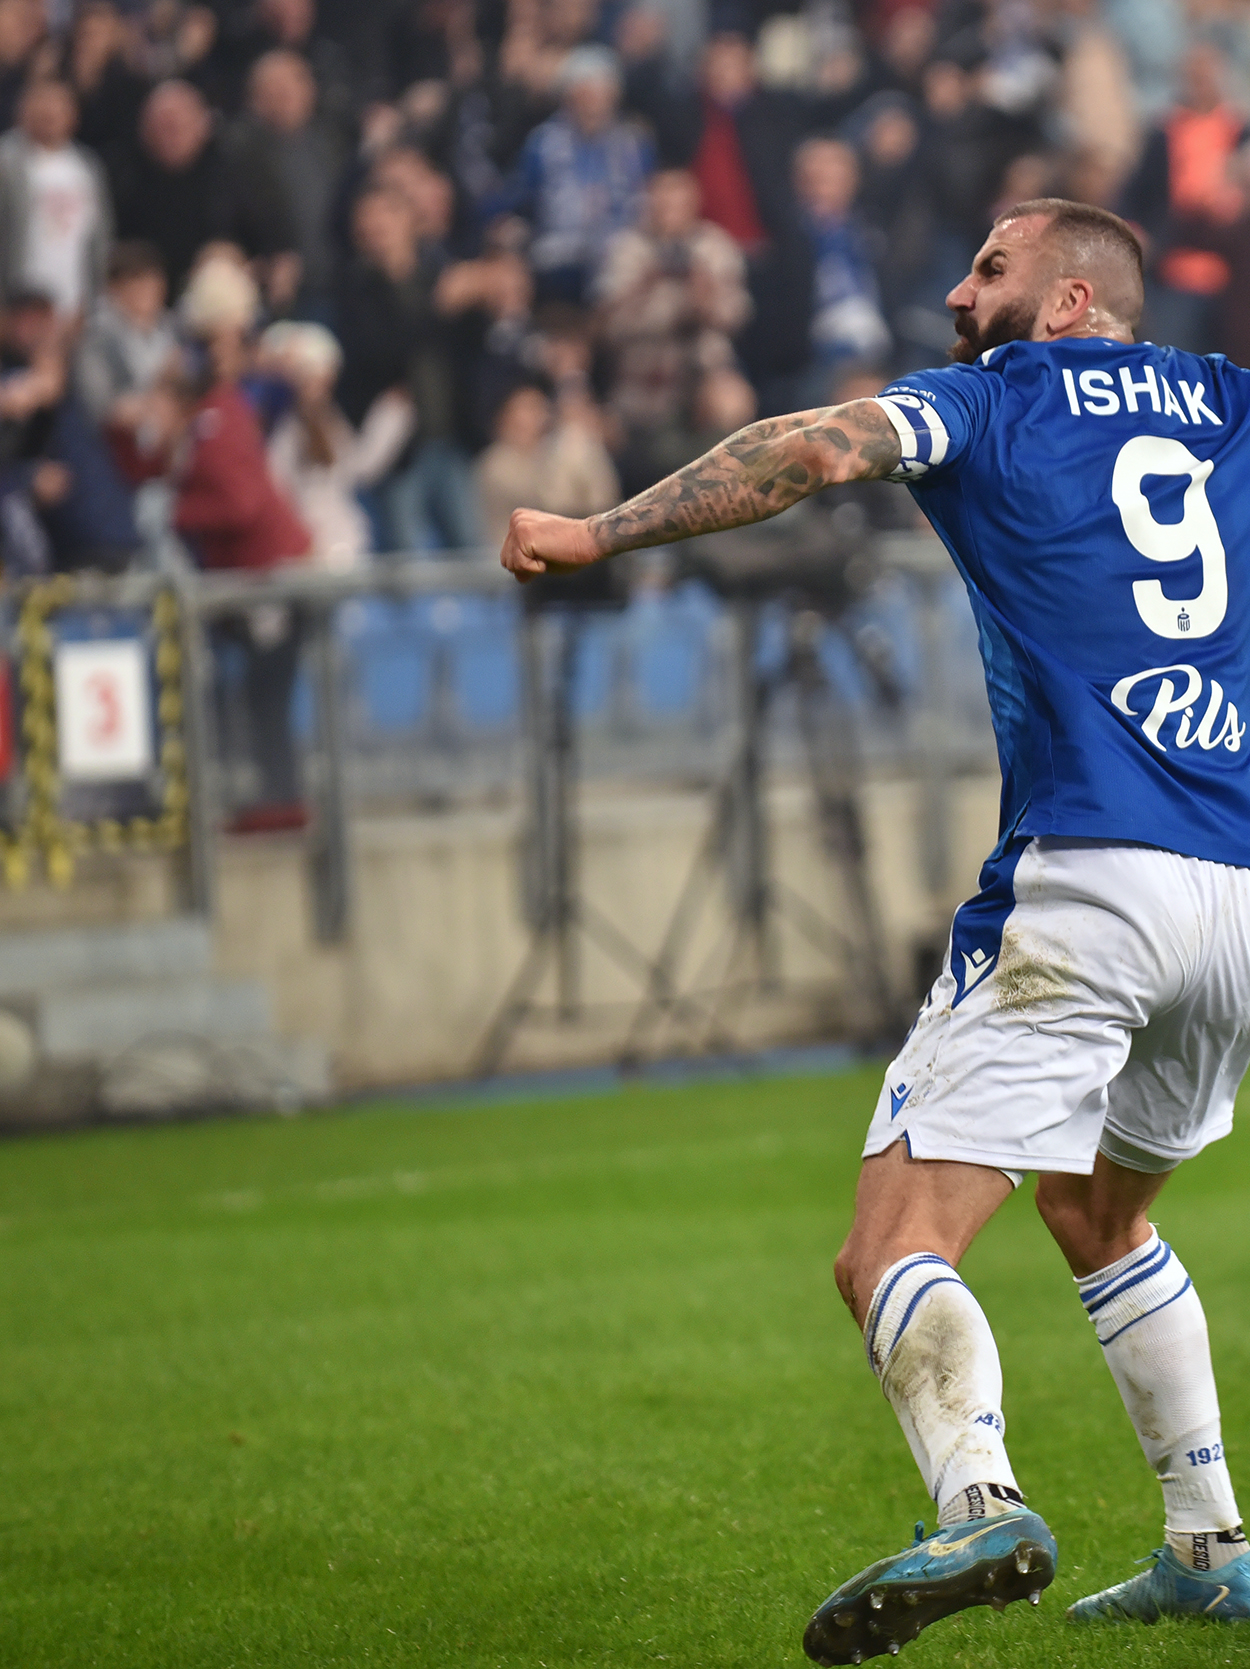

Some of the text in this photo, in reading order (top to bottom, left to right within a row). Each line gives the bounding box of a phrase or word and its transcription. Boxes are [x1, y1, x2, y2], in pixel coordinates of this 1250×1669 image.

[1062, 365, 1223, 425] ISHAK
[1111, 434, 1229, 640] 9
[1111, 664, 1246, 752] Pils
[1186, 1443, 1226, 1467] 192
